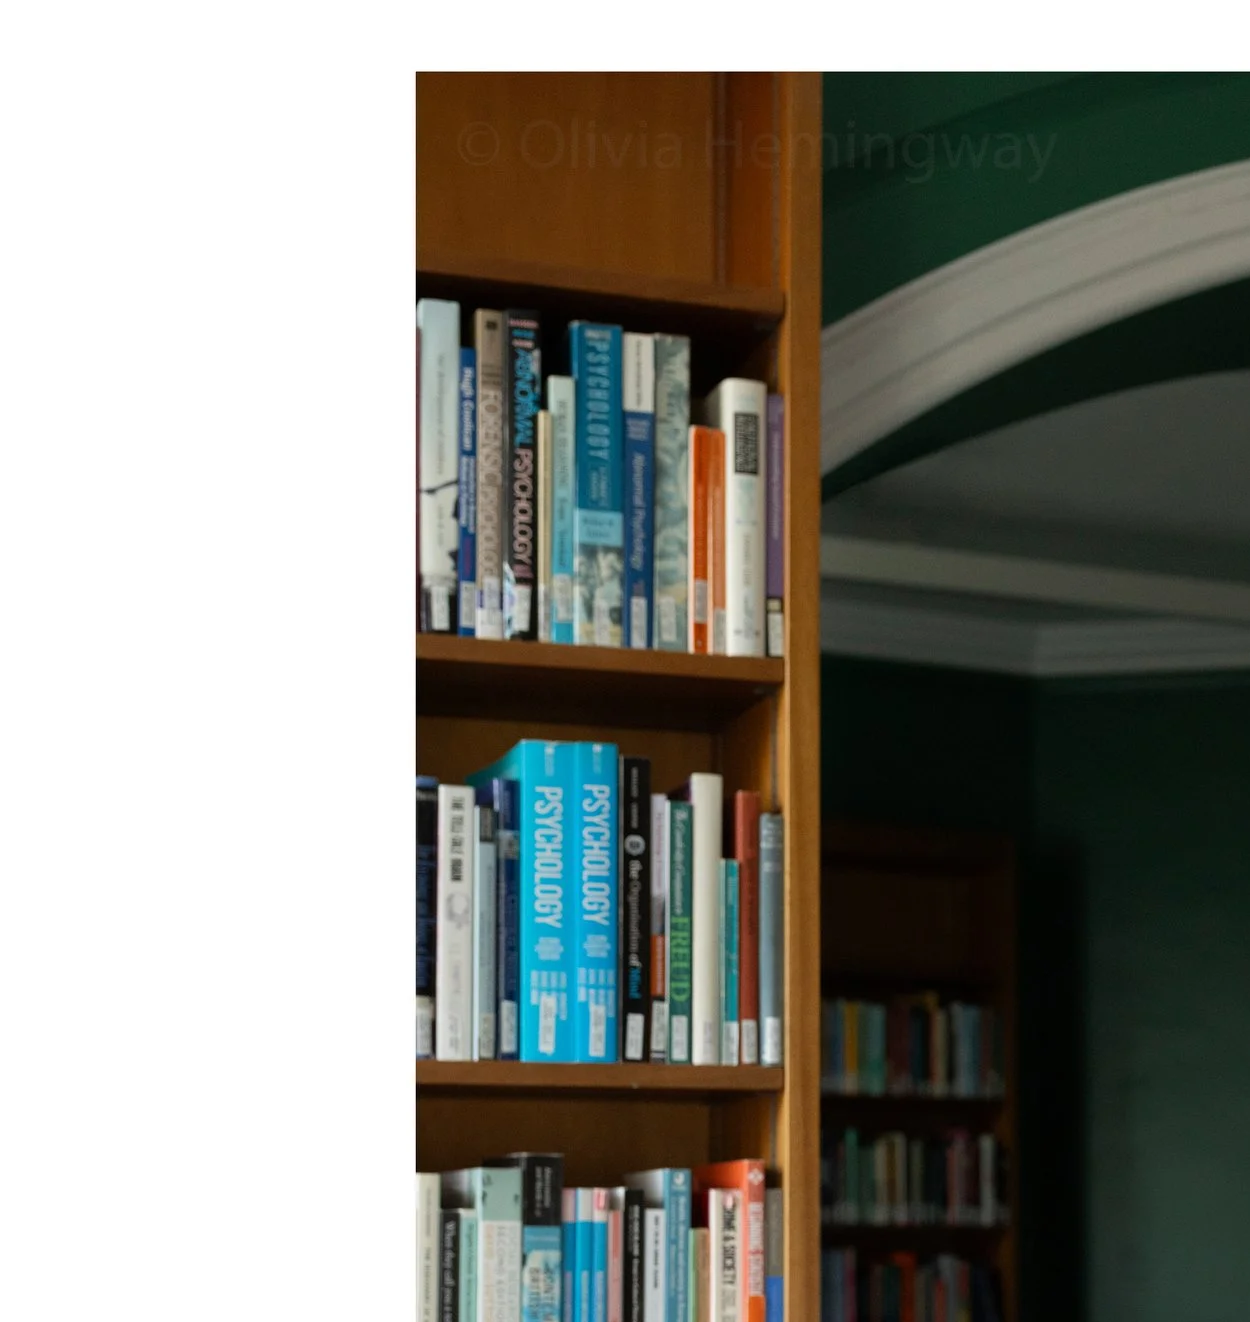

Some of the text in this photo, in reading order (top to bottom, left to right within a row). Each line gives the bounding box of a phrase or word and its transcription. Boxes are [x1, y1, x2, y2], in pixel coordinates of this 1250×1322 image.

[512, 348, 534, 563] ABNORMAL PSYCHOLOGY
[586, 341, 611, 461] PSYCHOLOGY
[480, 389, 502, 577] FORENSIC PSYCHOLOG
[533, 785, 564, 929] PSYCHOLOGY
[581, 783, 611, 926] PSYCHOLOGY
[670, 917, 691, 1002] FREUD
[723, 1245, 738, 1285] SOCIETY
